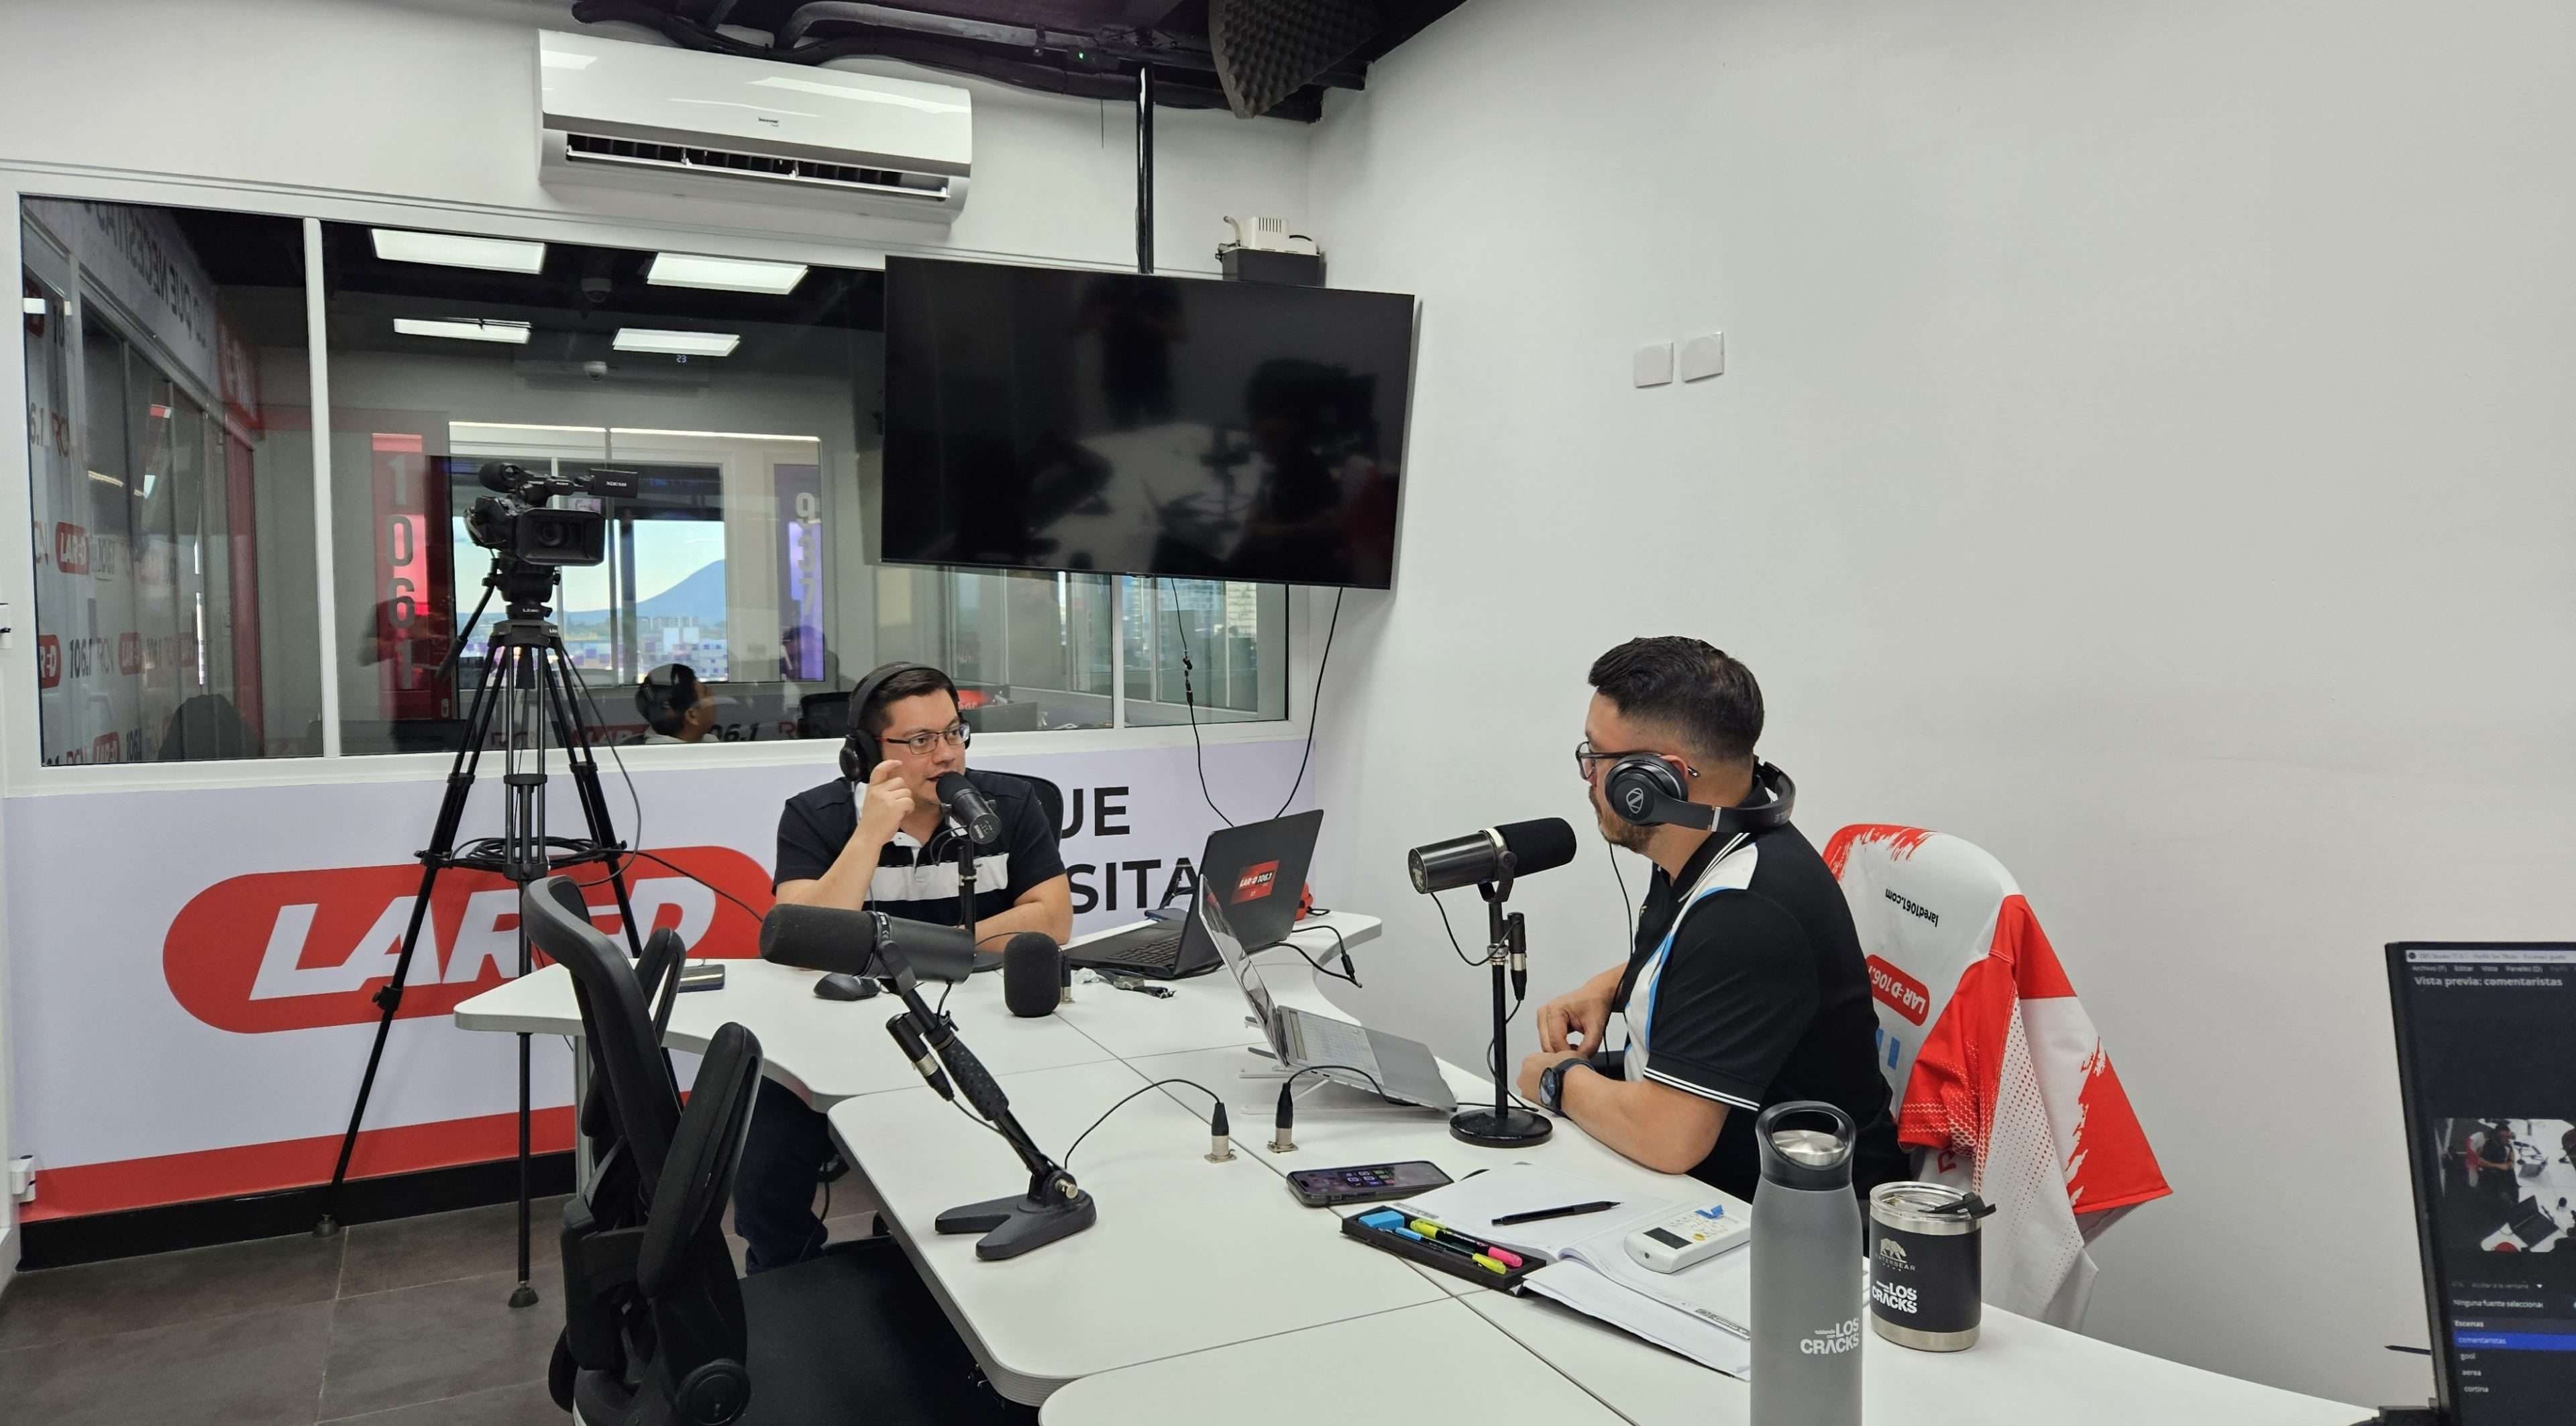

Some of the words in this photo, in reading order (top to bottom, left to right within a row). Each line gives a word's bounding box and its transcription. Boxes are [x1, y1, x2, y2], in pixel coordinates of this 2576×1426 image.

[1061, 786, 1130, 839] UE
[1885, 888, 1939, 927] lared1061.com
[2414, 976, 2443, 986] Vista
[2445, 976, 2482, 988] previa:
[2484, 977, 2563, 986] comentaristas
[1872, 1285, 1918, 1314] CRACKS
[1889, 1282, 1917, 1301] LOS
[1835, 1317, 1859, 1338] LOS
[2454, 1320, 2484, 1328] Escenas
[1800, 1332, 1859, 1354] CRACKS
